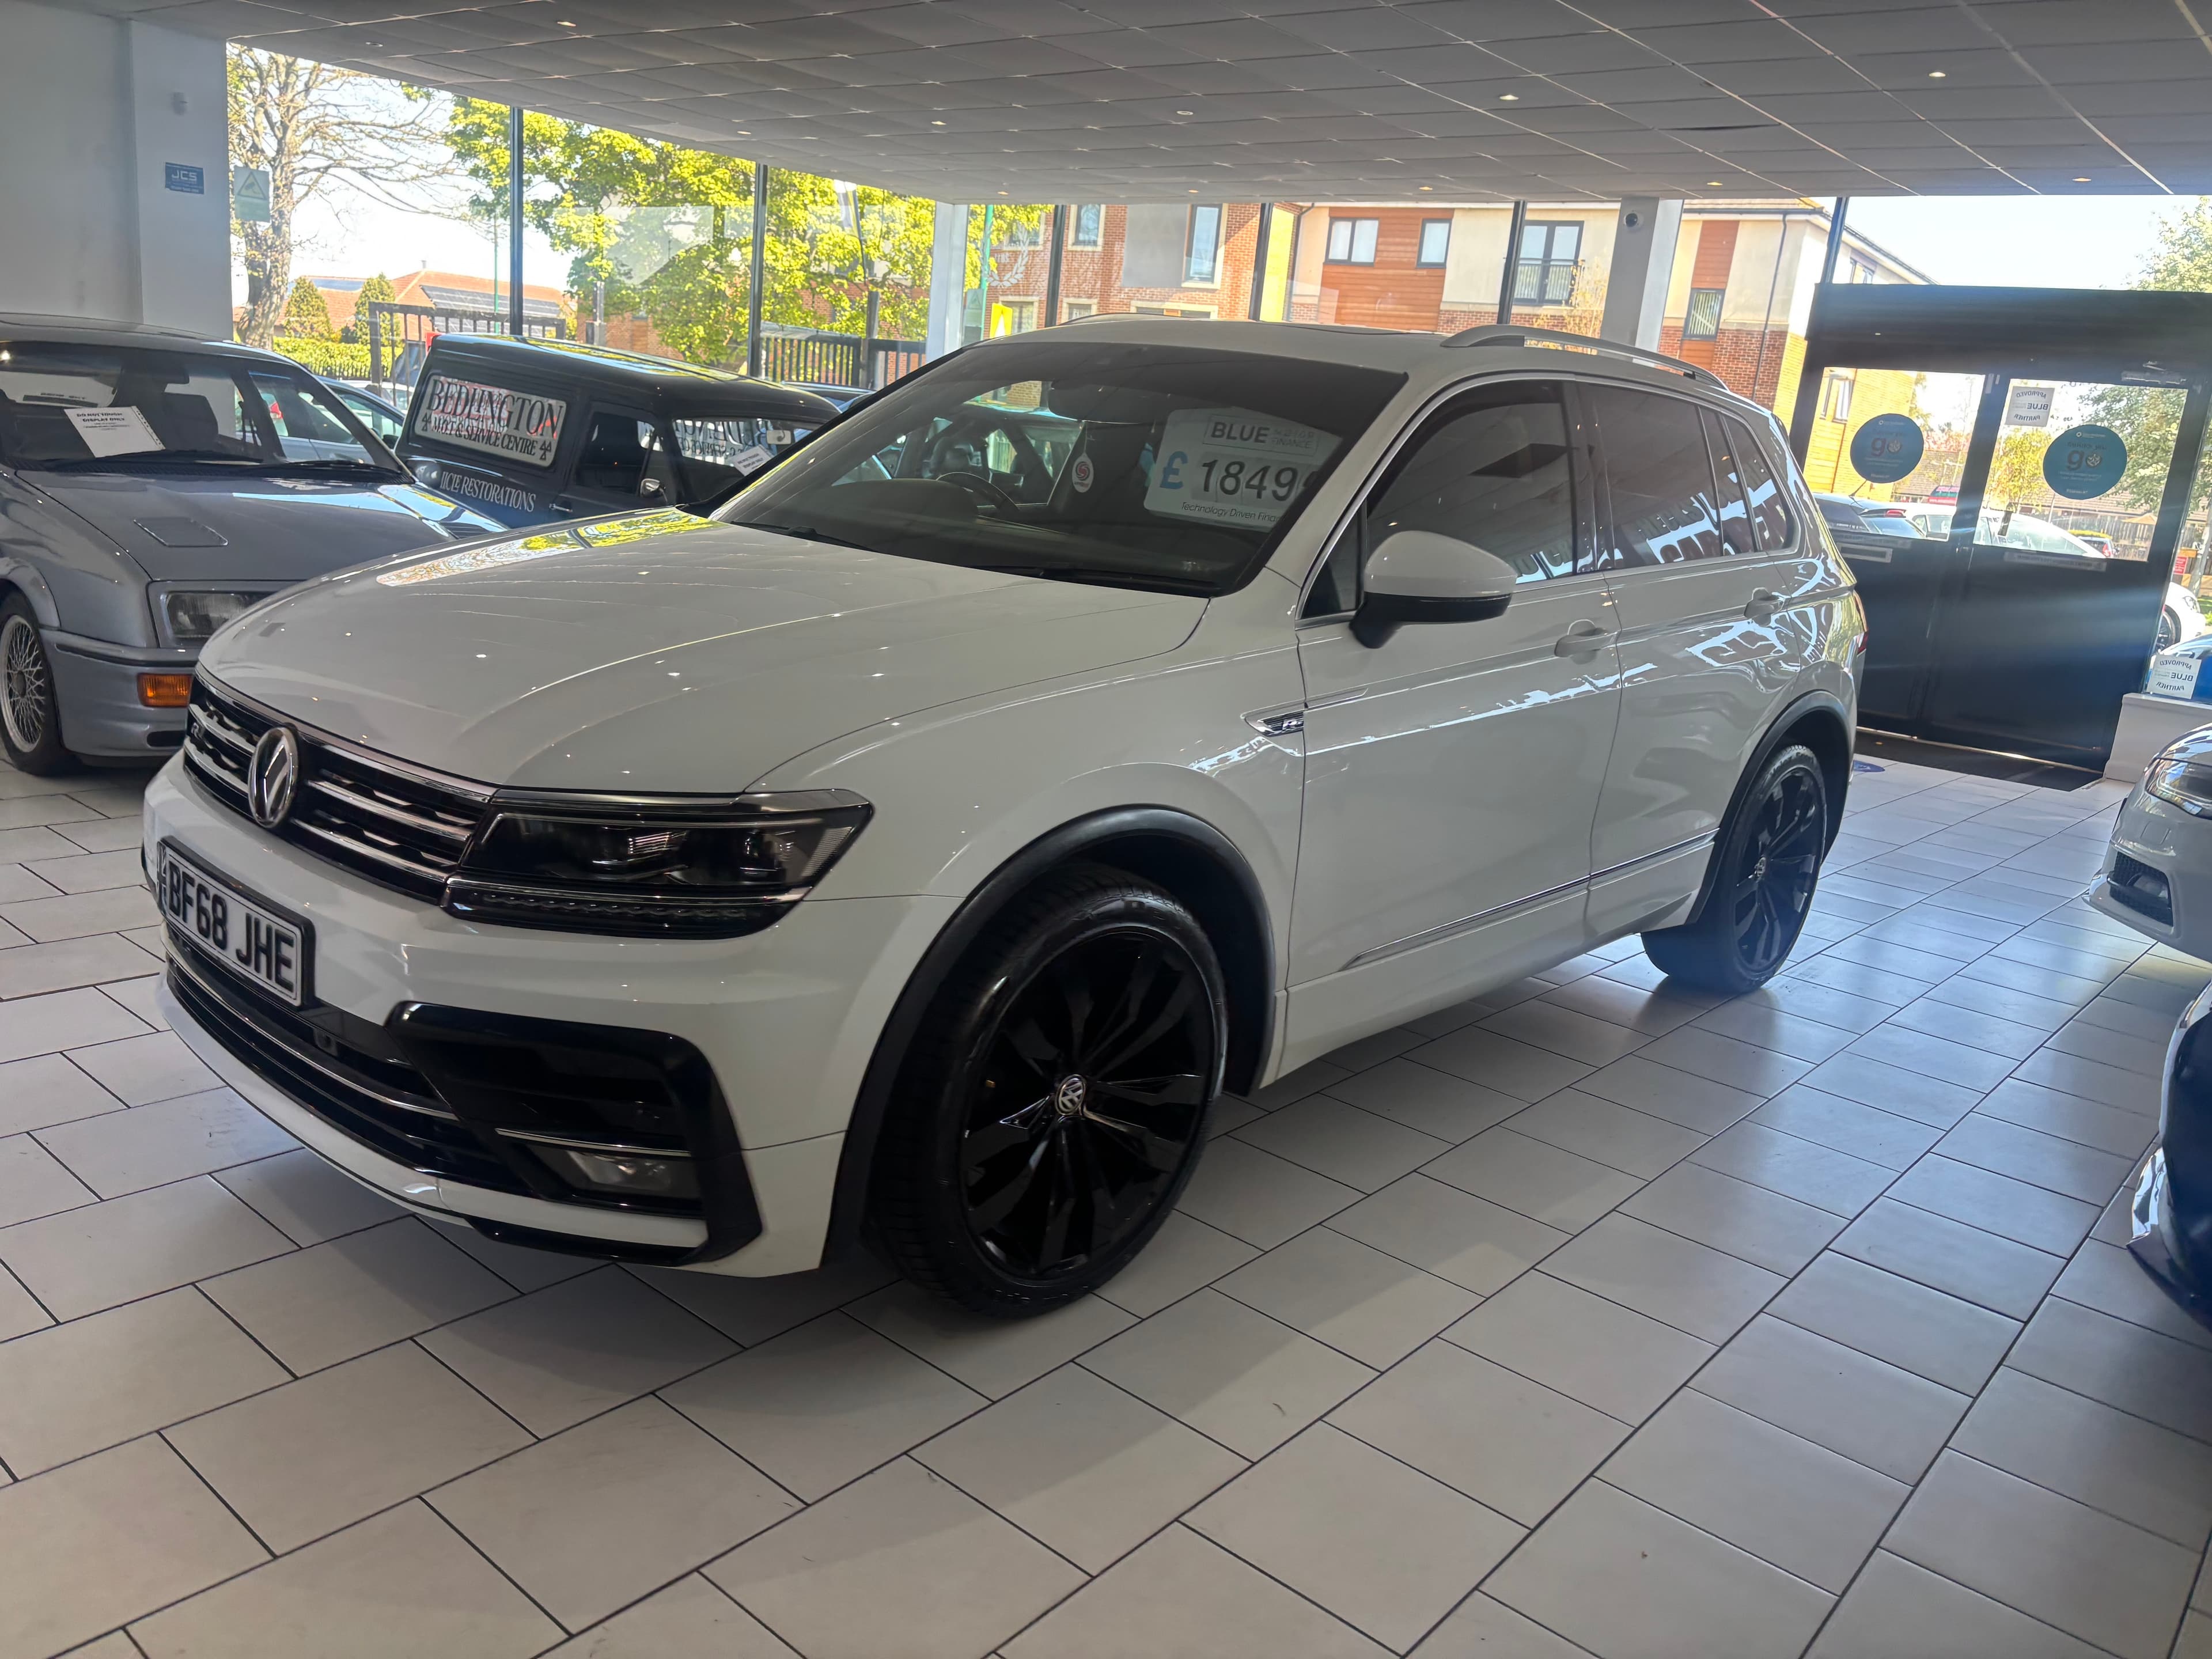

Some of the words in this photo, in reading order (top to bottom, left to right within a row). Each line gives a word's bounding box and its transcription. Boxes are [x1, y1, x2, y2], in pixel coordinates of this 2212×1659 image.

[172, 170, 197, 181] JCS
[427, 379, 564, 438] BEDLINGTON
[463, 424, 502, 448] SERVICE
[501, 433, 538, 456] CENTRE
[1211, 421, 1270, 444] BLUE
[1160, 450, 1188, 489] £
[460, 476, 536, 512] RESTORATIONS
[1181, 502, 1228, 517] Technology
[1229, 508, 1256, 518] Driven
[1257, 512, 1281, 522] Fina
[168, 861, 228, 951] BF68
[235, 912, 294, 993] JHE
